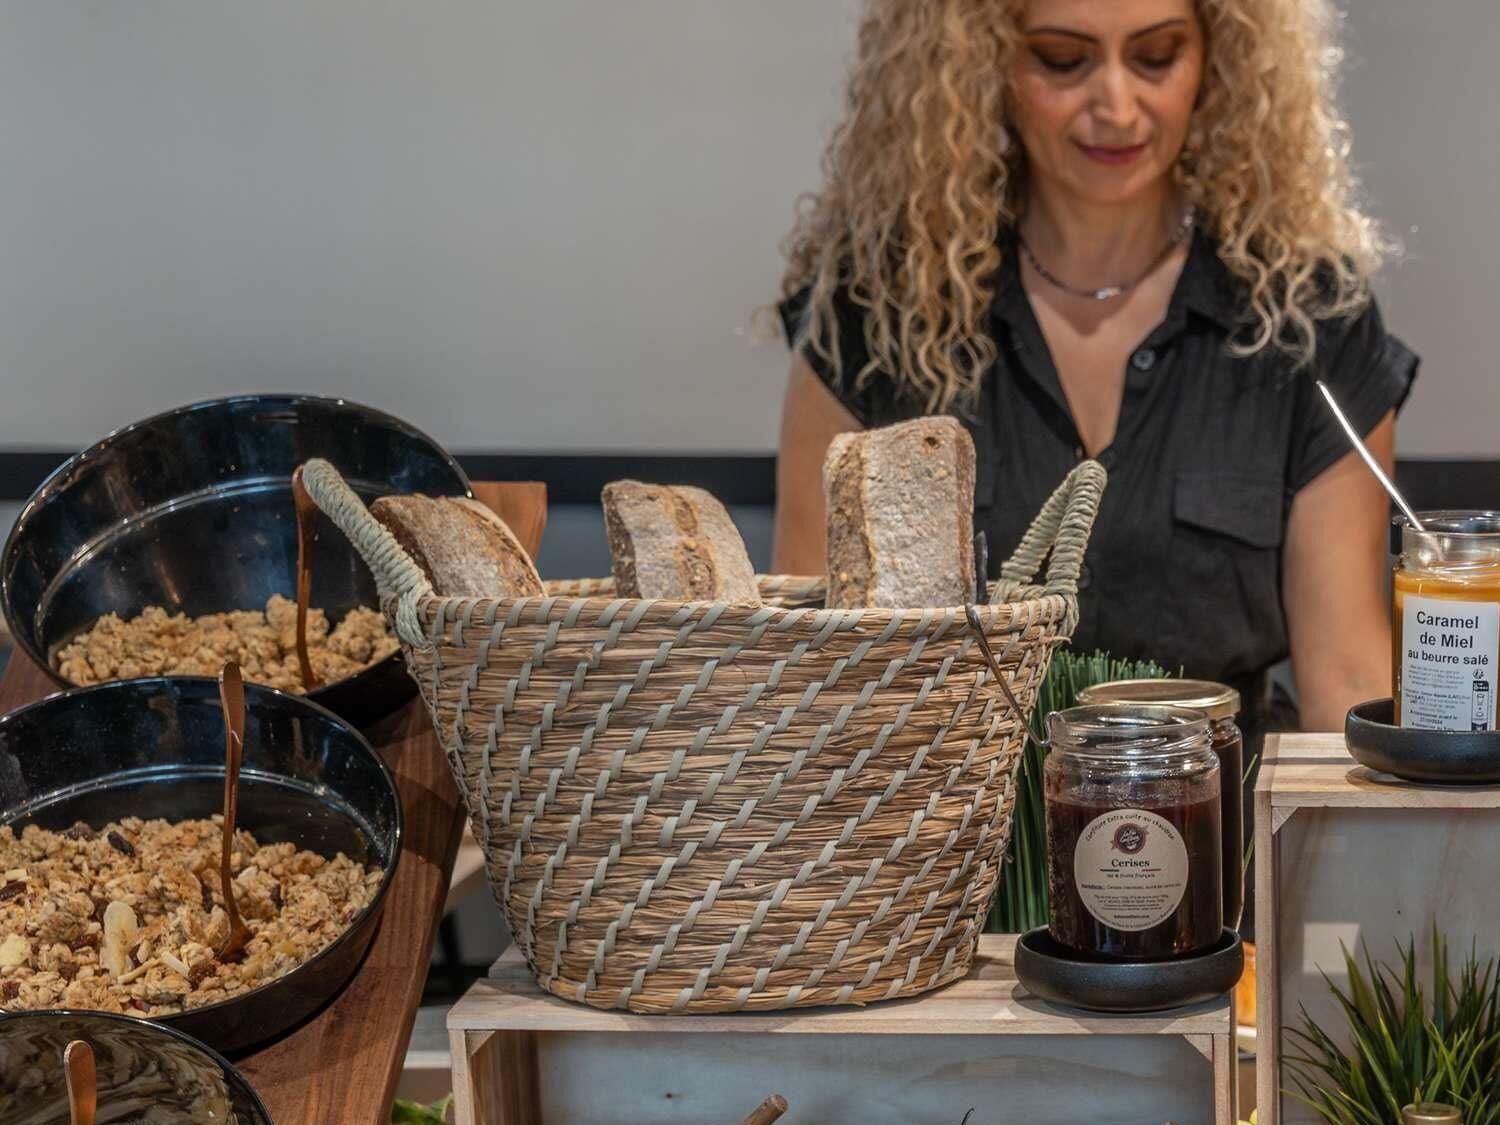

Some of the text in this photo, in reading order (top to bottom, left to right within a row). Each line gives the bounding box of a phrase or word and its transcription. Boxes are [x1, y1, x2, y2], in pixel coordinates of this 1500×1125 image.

[1417, 611, 1479, 629] Caramel
[1420, 632, 1473, 648] de Miel
[1408, 650, 1489, 665] au beurre salé
[1111, 858, 1150, 867] Cerises
